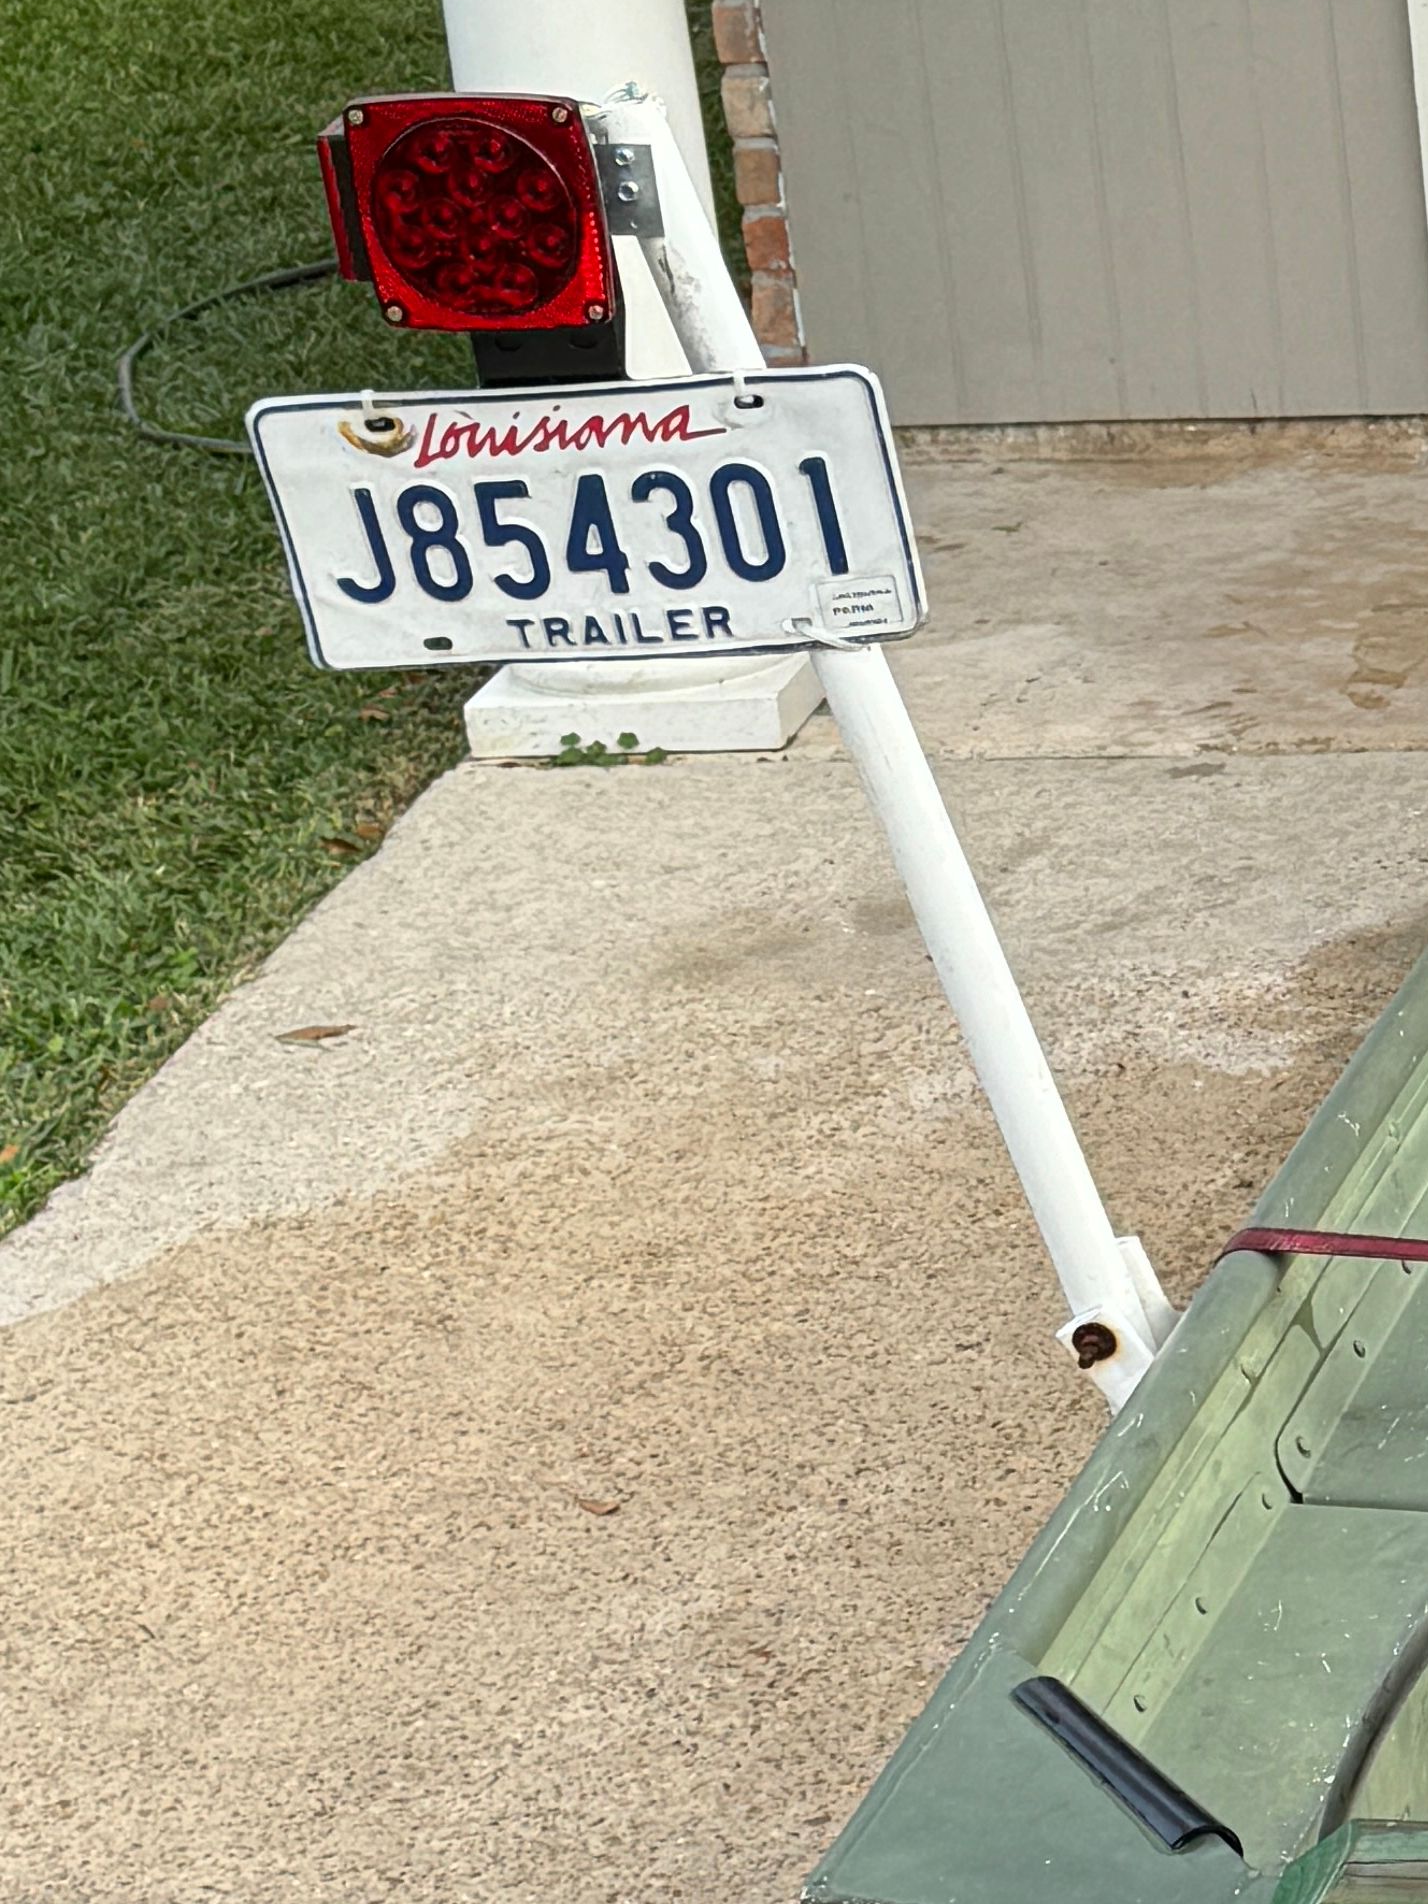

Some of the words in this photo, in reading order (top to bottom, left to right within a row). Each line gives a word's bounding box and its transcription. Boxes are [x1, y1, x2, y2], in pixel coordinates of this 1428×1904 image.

[414, 404, 727, 469] Louisiana
[336, 456, 850, 604] J854301
[506, 606, 734, 648] TRAILER
